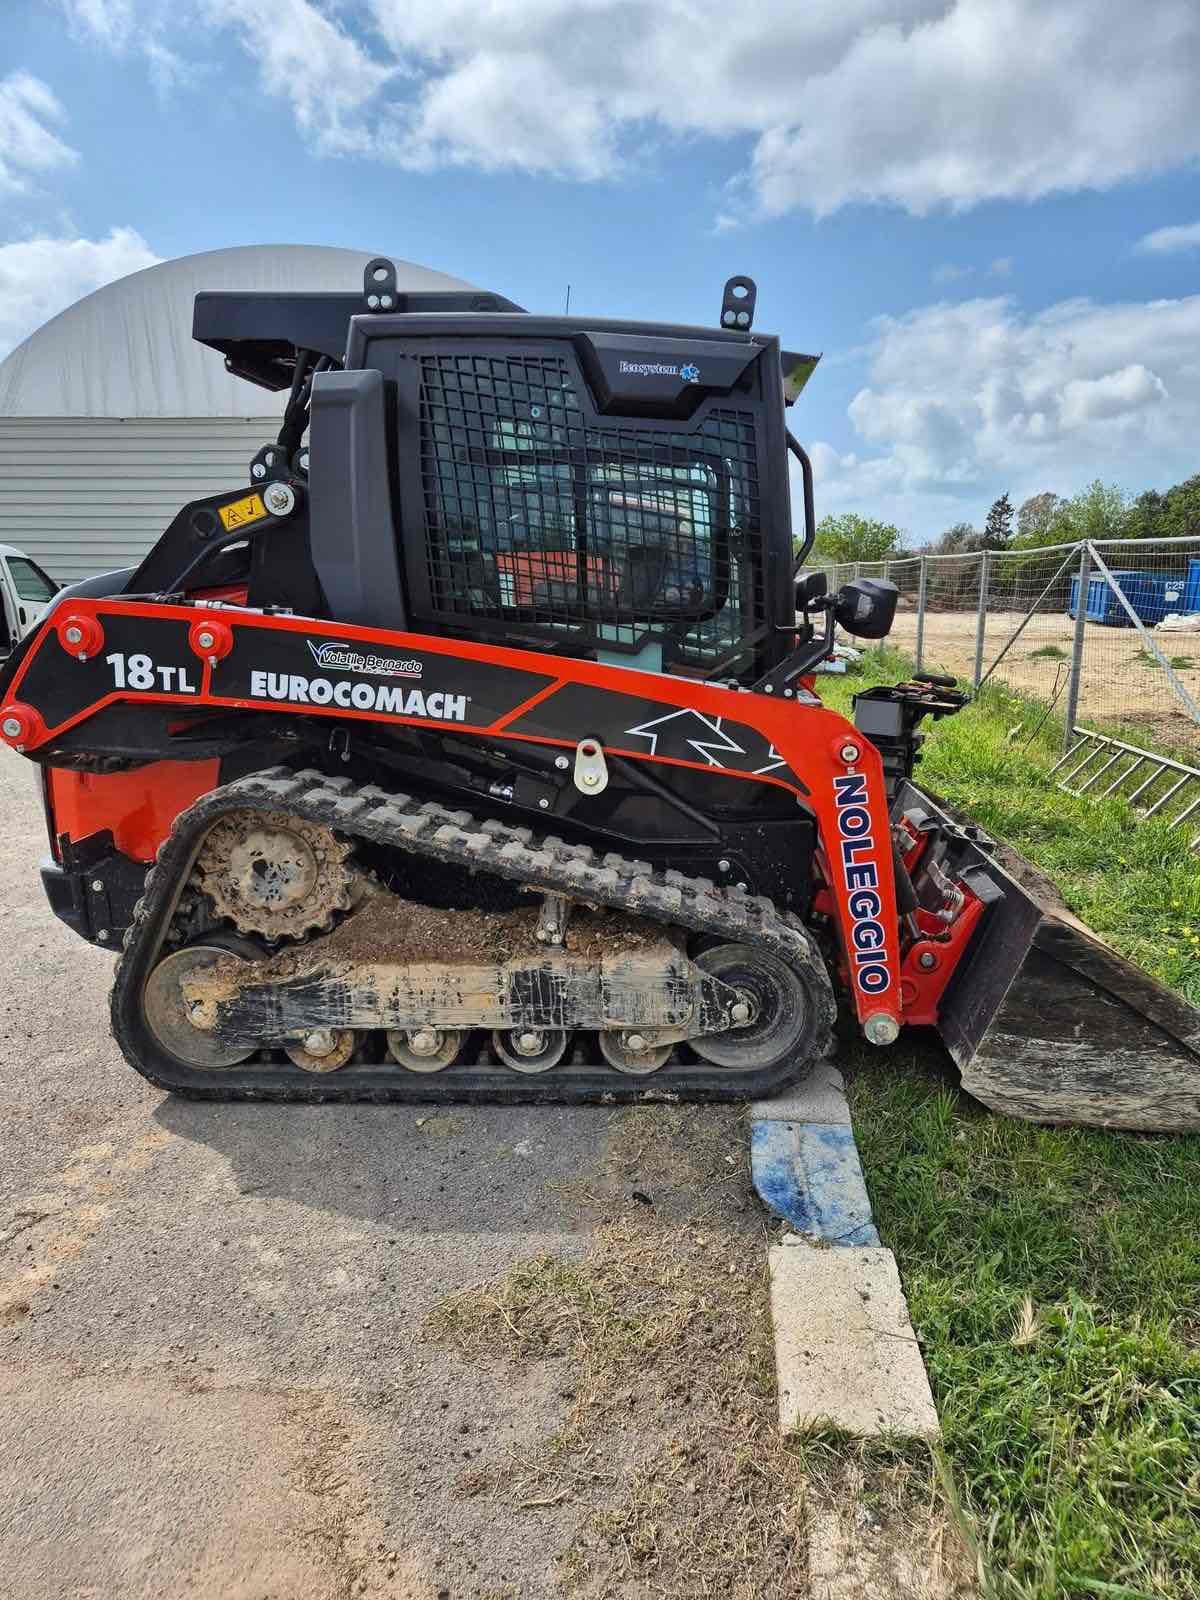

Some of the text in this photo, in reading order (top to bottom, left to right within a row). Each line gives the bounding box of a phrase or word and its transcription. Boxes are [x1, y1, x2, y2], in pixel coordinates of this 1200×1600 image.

[322, 650, 365, 666] Volatile
[366, 654, 423, 673] Bernardo
[250, 670, 467, 721] EUROCOMACH
[832, 774, 891, 995] NOLEGGIO
